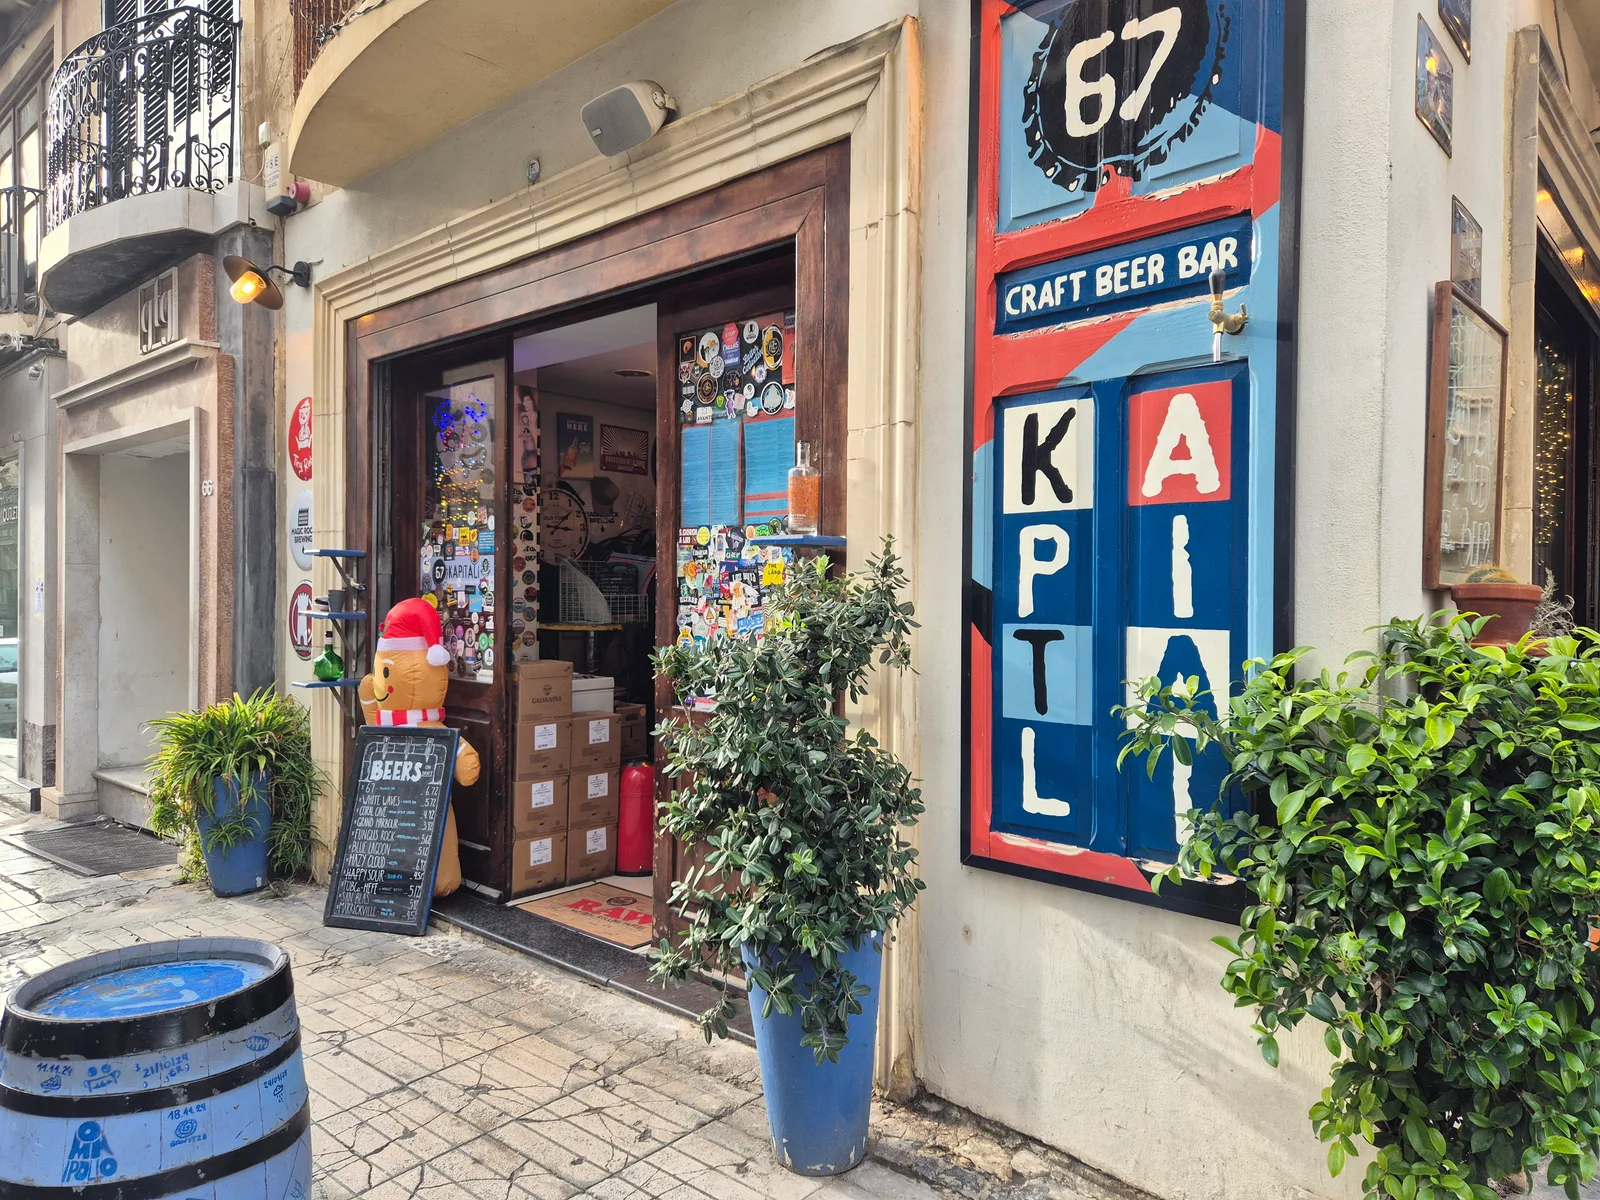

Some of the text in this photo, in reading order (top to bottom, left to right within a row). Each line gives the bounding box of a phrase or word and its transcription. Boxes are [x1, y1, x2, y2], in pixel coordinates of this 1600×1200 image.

[1064, 6, 1182, 137] 67
[1005, 237, 1239, 315] CRAFT BEER BAR
[566, 423, 588, 431] HERE
[293, 453, 303, 474] Tiny
[202, 480, 213, 497] 66
[549, 492, 559, 500] 12
[568, 499, 572, 507] 1
[575, 510, 581, 518] 2
[580, 523, 586, 532] 3
[294, 535, 313, 543] BREWING
[435, 565, 480, 579] 67 KAPITALI
[369, 760, 423, 782] BEERS
[365, 783, 376, 793] 67
[362, 794, 381, 805] WHITE
[351, 840, 368, 854] BLUE
[348, 853, 366, 867] HAZY
[367, 855, 386, 869] CLOUD
[564, 898, 652, 925] RAW
